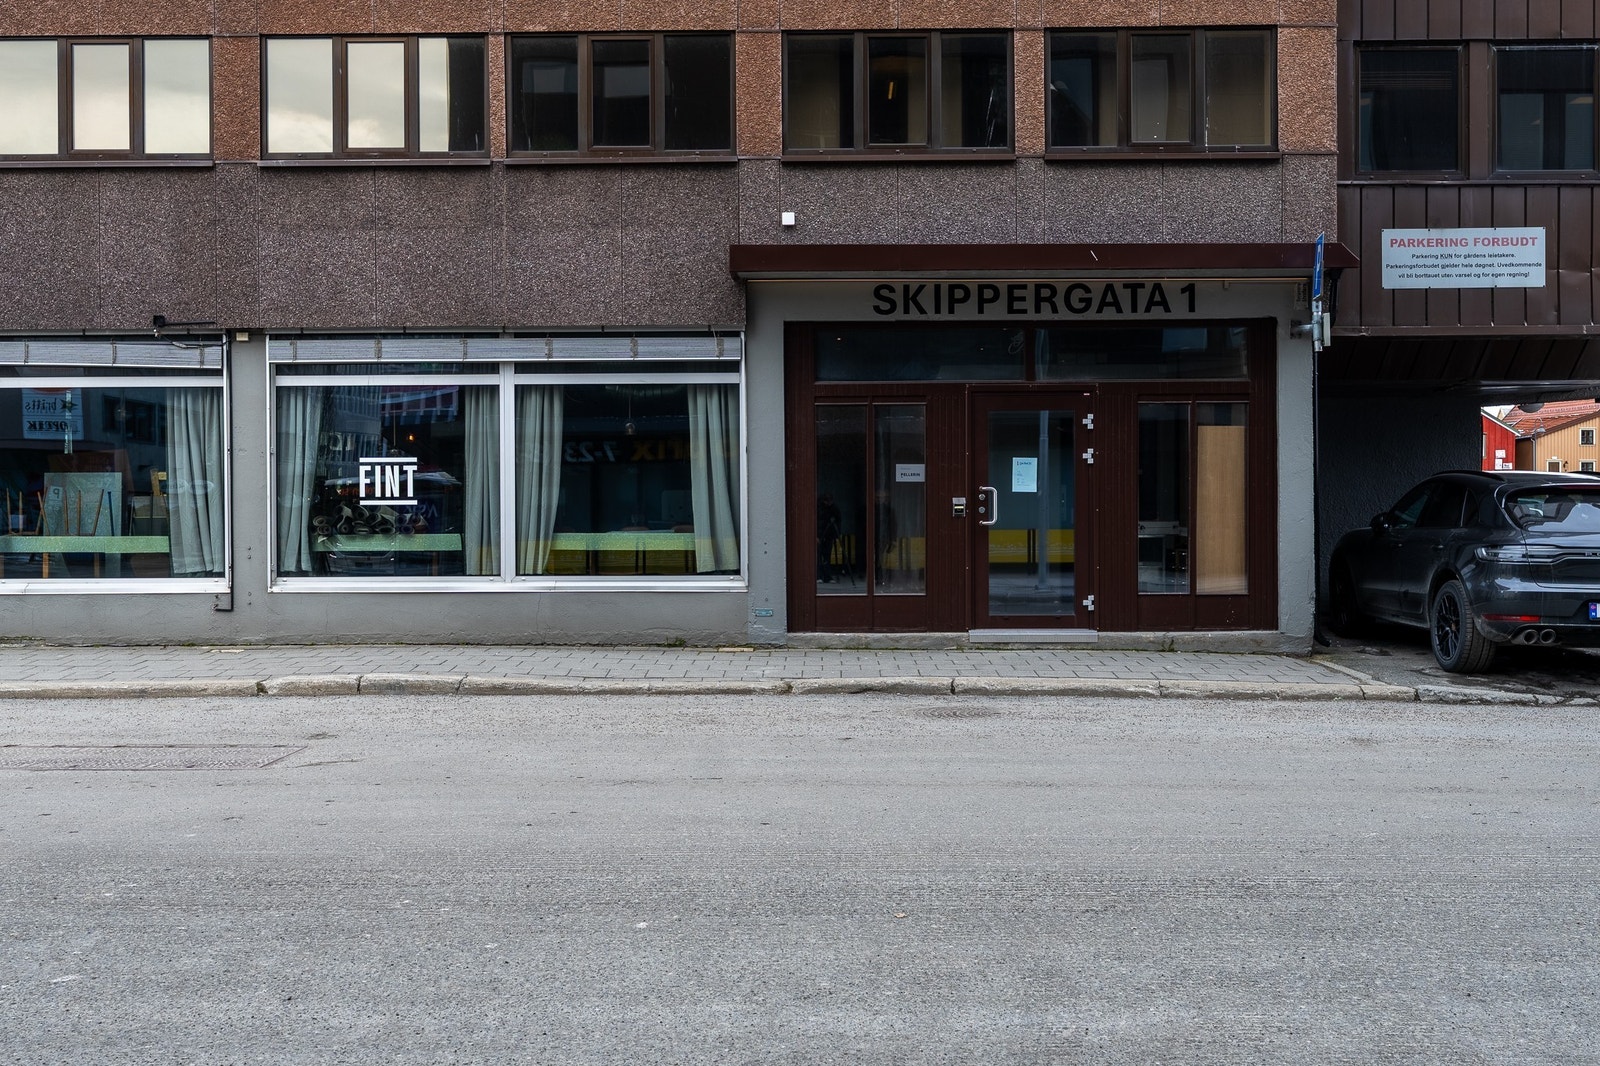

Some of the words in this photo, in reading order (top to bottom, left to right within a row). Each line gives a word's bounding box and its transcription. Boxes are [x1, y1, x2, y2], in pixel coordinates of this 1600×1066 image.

[1390, 238, 1468, 248] PARKERING
[1473, 237, 1538, 247] FORBUDT
[872, 283, 1172, 315] SKIPPERGATA
[1180, 283, 1197, 313] 1
[359, 465, 418, 498] FINT
